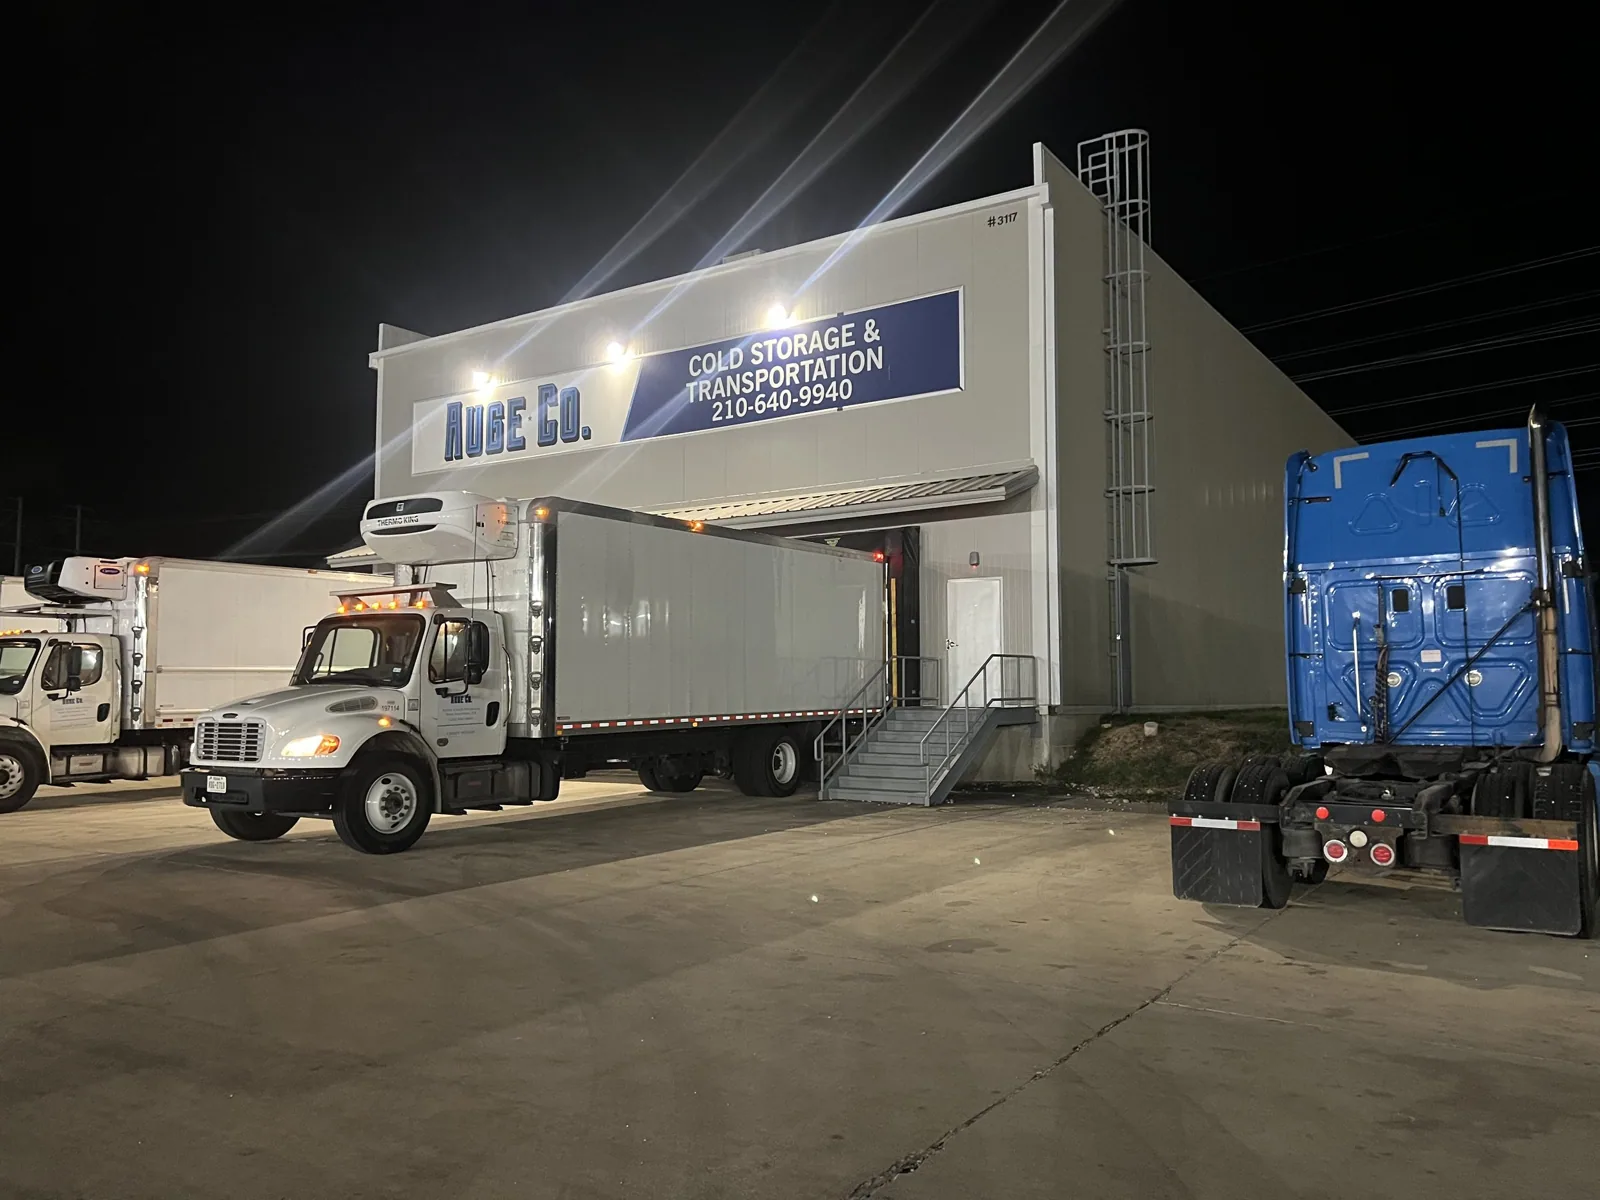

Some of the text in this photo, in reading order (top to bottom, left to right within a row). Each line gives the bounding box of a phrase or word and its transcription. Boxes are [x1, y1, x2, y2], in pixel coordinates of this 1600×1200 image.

[987, 212, 1018, 228] #3117
[689, 318, 881, 377] COLD STORAGE &
[686, 346, 883, 403] TRANSPORTATION
[712, 379, 853, 422] 210-640-9940
[444, 396, 527, 462] AUGE
[377, 515, 419, 527] THERMO KING
